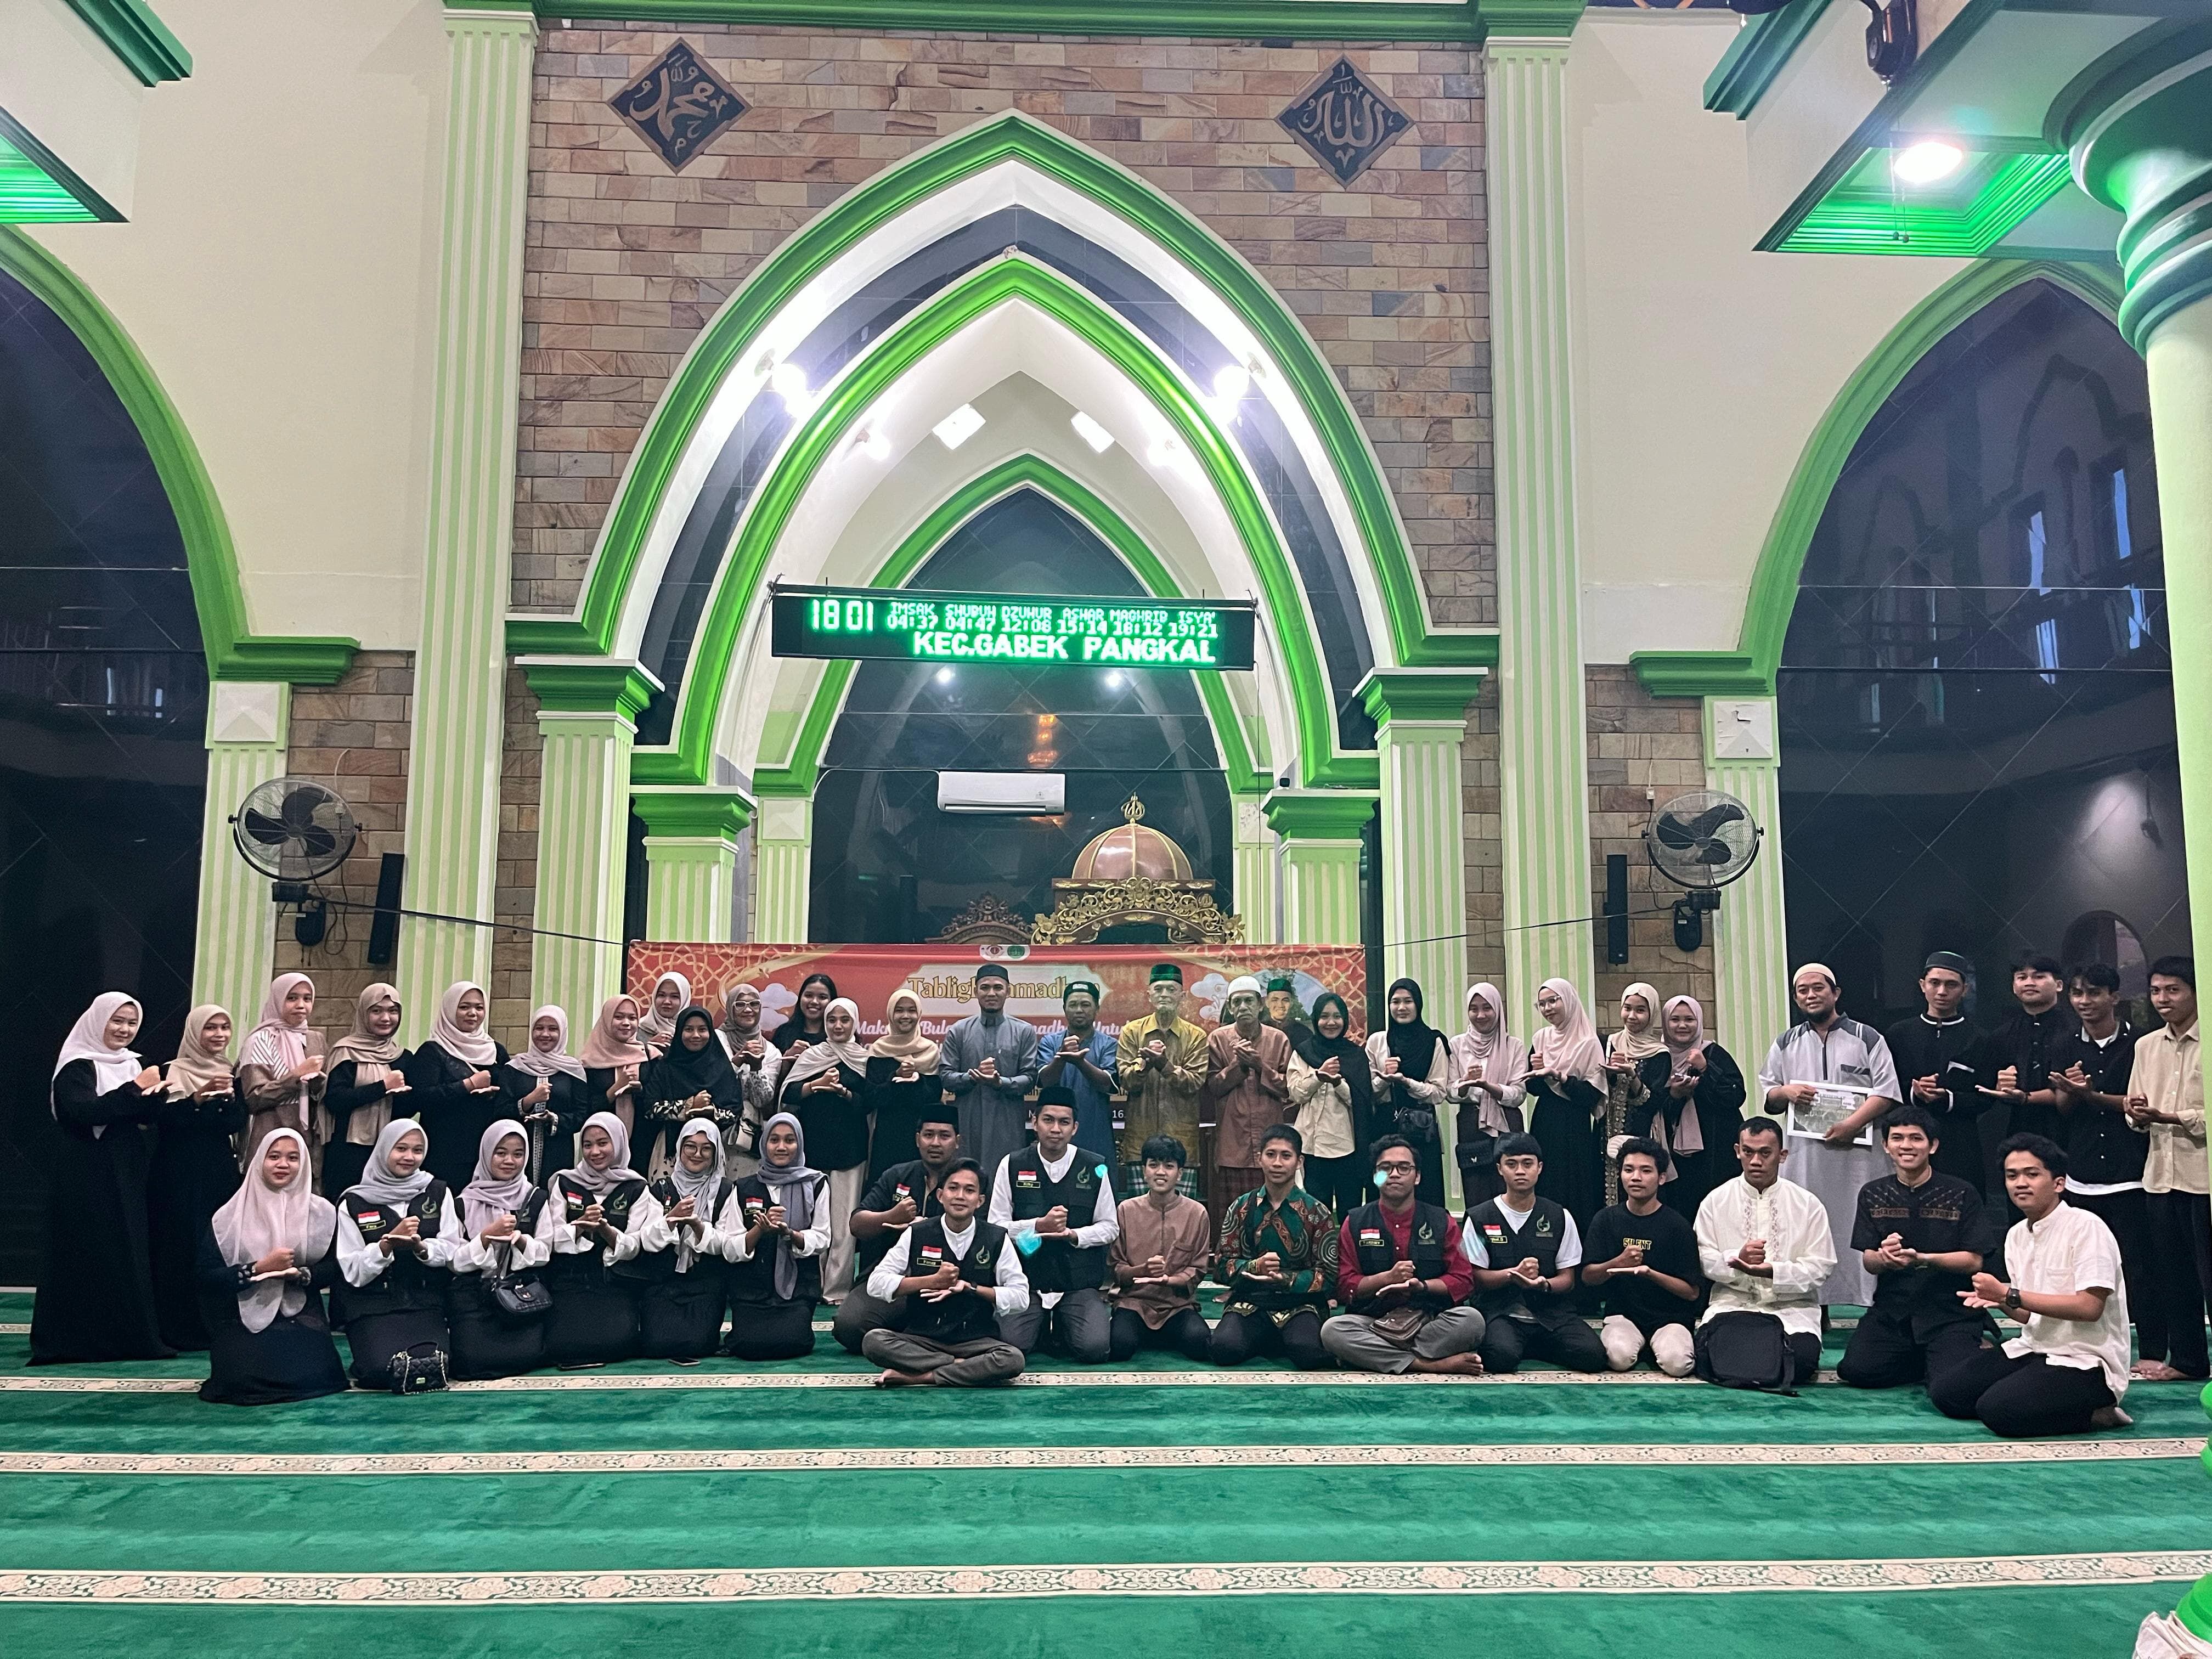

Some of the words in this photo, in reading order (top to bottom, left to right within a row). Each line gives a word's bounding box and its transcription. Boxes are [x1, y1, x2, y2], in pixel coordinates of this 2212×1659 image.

[891, 602, 935, 616] IMSAK
[1062, 607, 1104, 621] ASHAR
[886, 615, 938, 629] 04:37
[945, 617, 996, 631] 04:47
[1057, 619, 1108, 635] 15:14
[1113, 621, 1163, 636] 18:12
[1167, 623, 1218, 639] 19:21
[913, 631, 1069, 659] KEC.GABEK
[1082, 636, 1216, 663] PANGKAL
[1092, 1020, 1130, 1035] Untu
